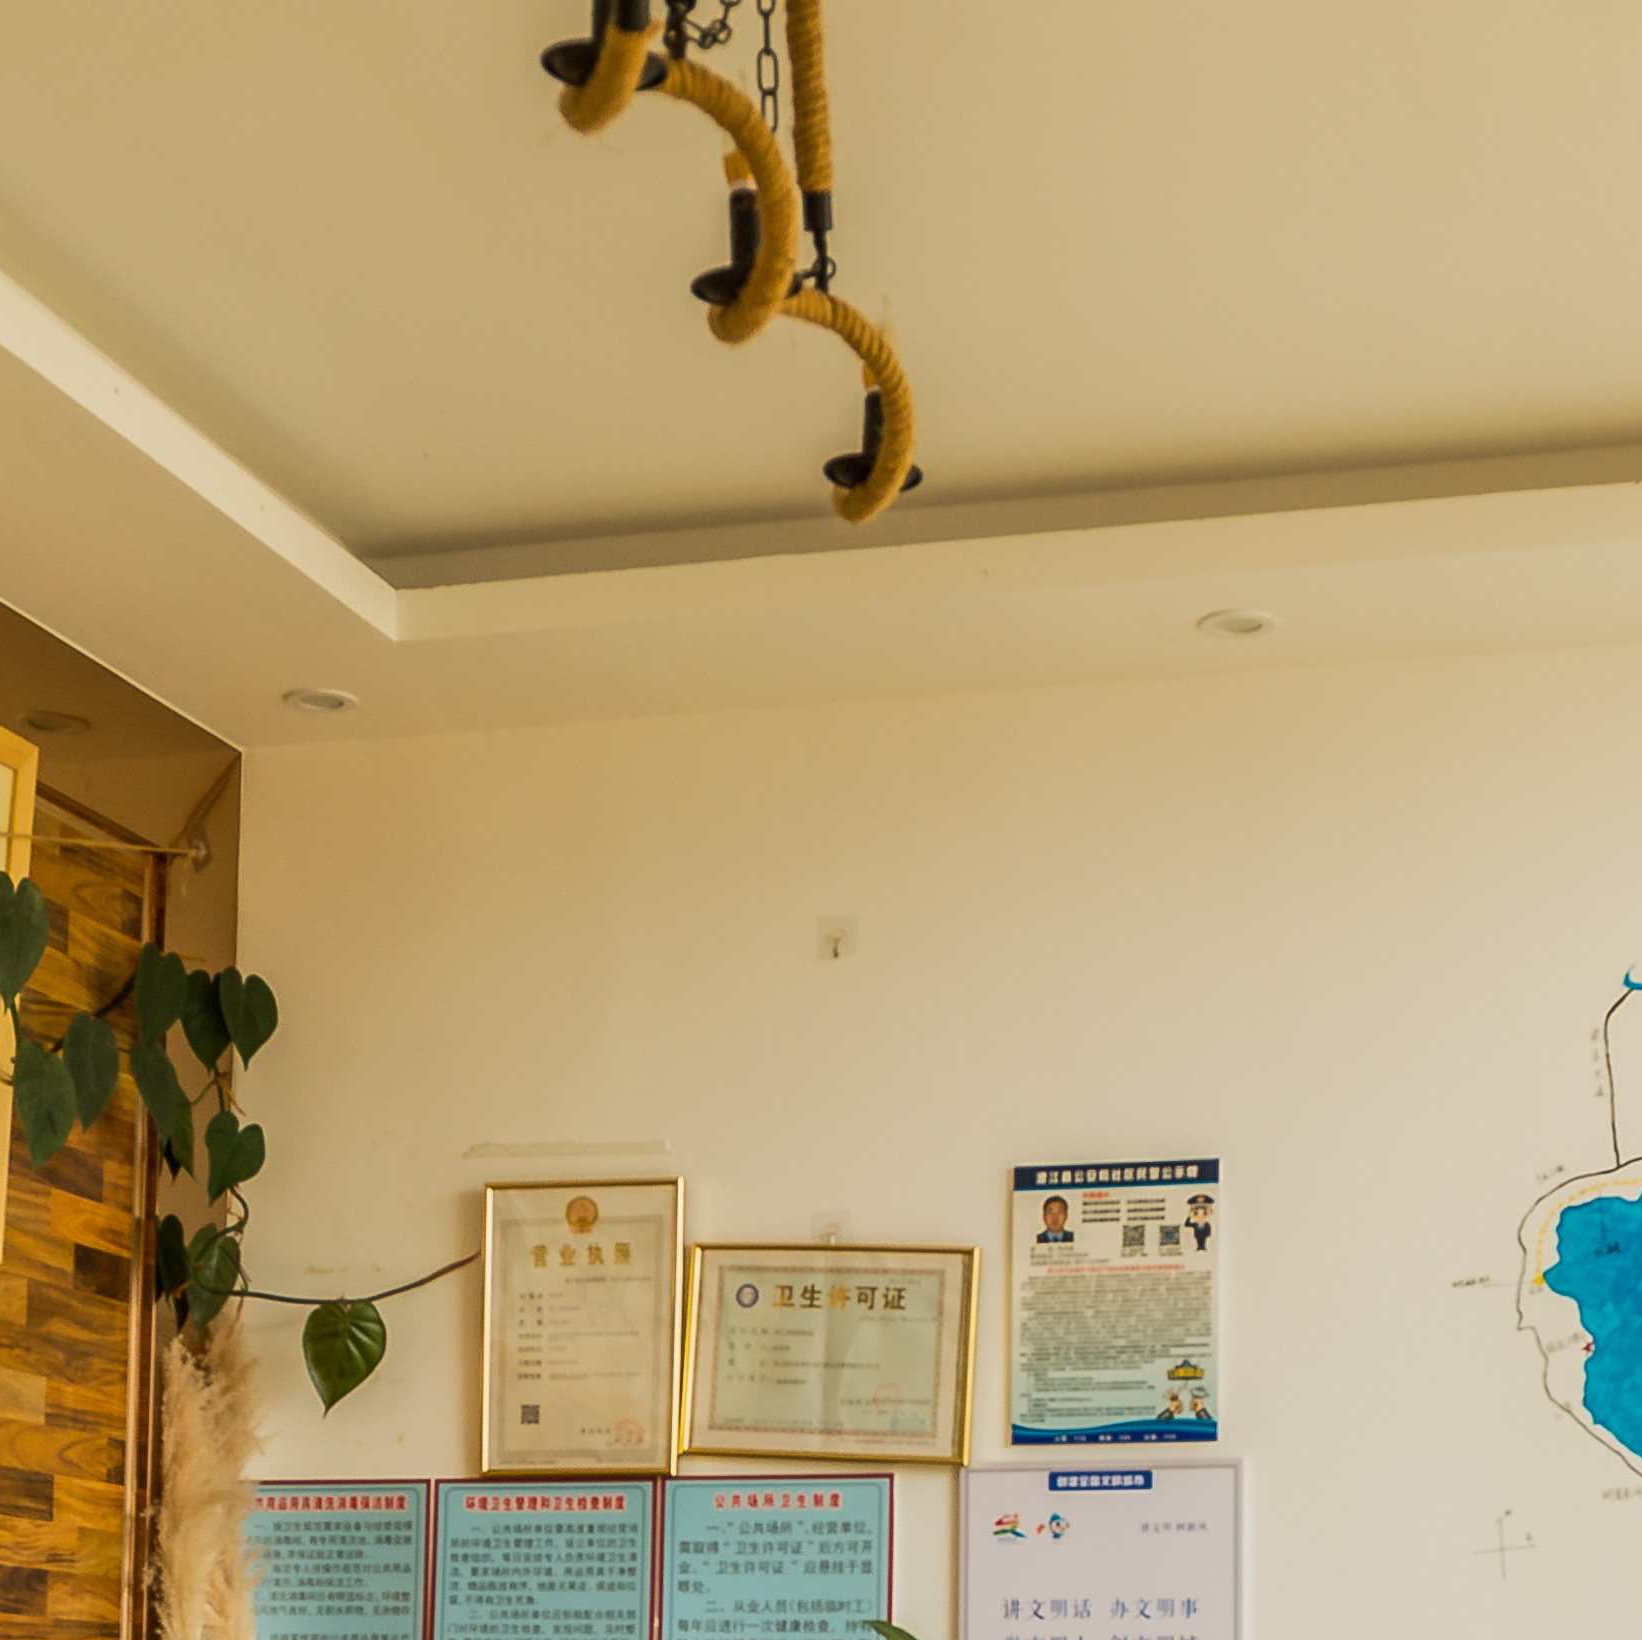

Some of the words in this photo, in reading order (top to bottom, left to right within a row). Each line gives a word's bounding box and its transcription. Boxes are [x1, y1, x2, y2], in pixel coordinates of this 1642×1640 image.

[531, 1242, 631, 1268] 营业执照
[772, 1284, 907, 1310] 卫生许可证
[714, 1493, 842, 1509] 公共场所卫生制度
[1003, 1598, 1092, 1619] 讲文明话
[1109, 1598, 1199, 1619] 办文明事
